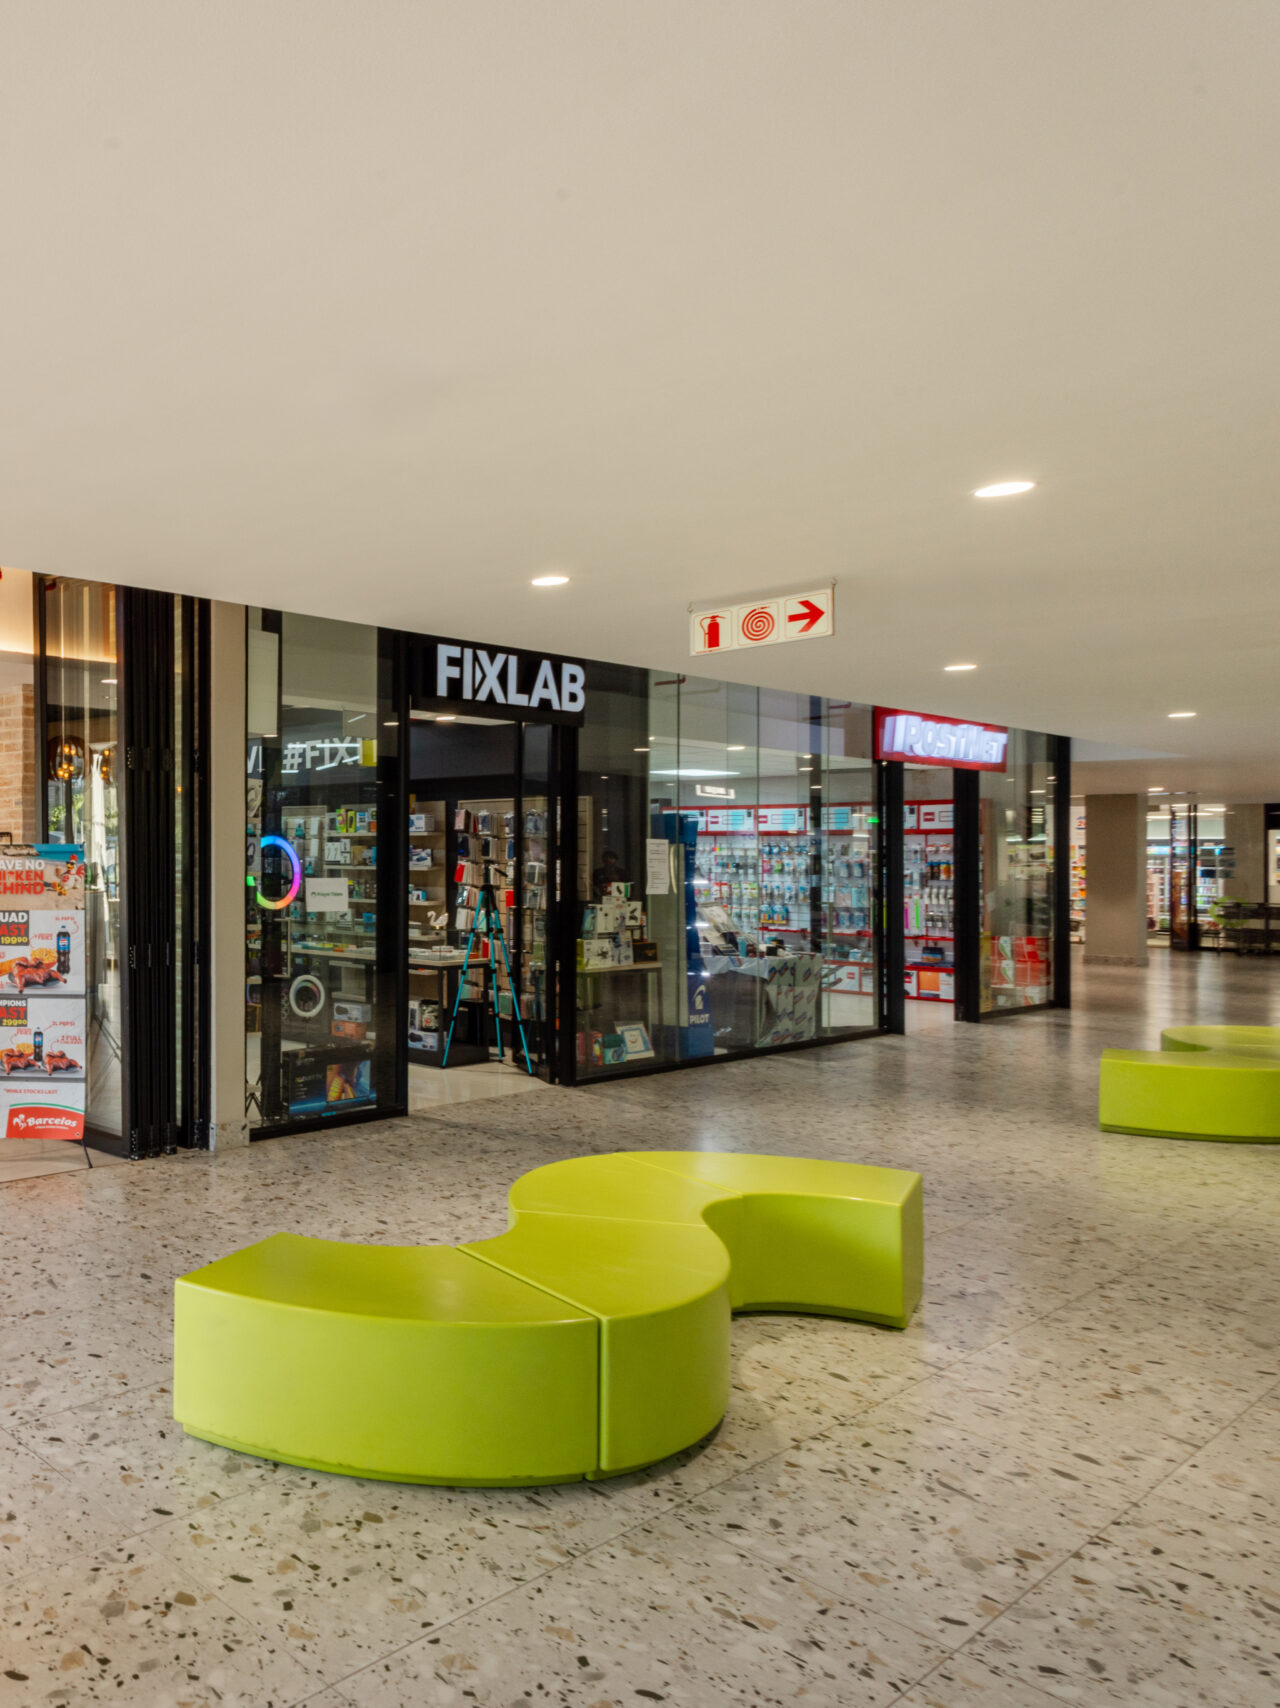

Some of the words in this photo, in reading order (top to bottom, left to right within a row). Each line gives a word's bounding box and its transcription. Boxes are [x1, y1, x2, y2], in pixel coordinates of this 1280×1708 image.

[436, 643, 586, 713] FIXLAB
[25, 860, 45, 870] NO
[689, 1013, 710, 1025] PILOT
[26, 1116, 78, 1127] Barcelos
